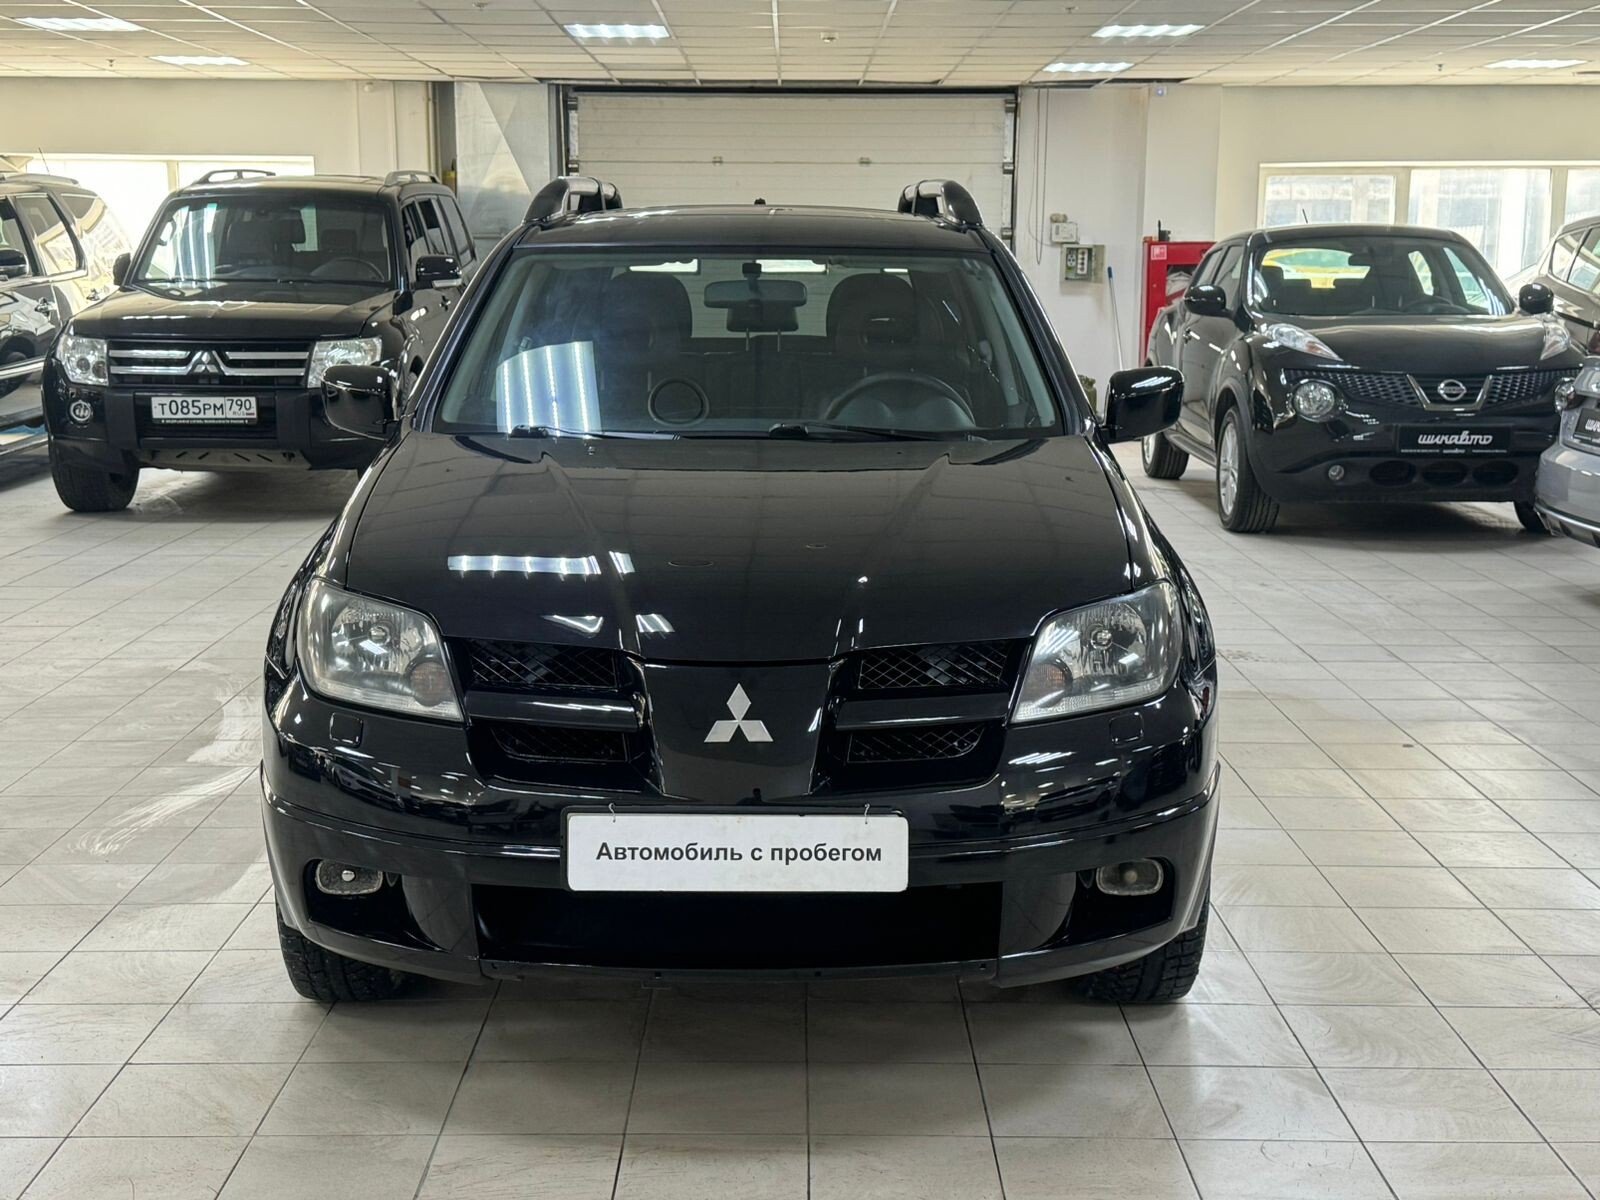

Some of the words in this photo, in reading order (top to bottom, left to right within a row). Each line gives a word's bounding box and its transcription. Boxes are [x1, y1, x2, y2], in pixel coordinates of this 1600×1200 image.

[158, 399, 225, 416] Т085РМ
[226, 398, 252, 411] 790
[595, 842, 743, 861] Автомобиль
[750, 848, 763, 861] с
[770, 843, 882, 866] пробегом
